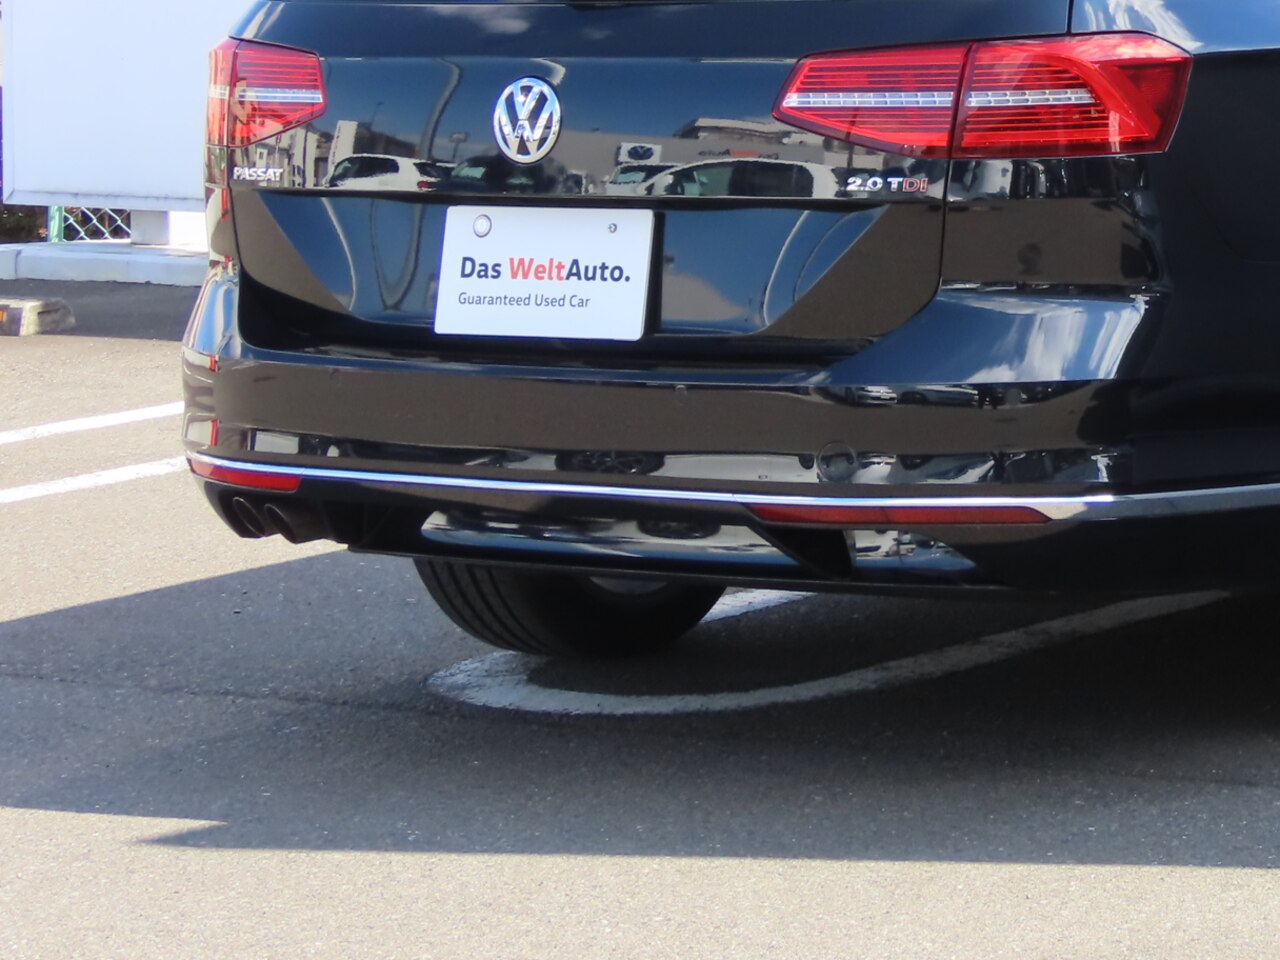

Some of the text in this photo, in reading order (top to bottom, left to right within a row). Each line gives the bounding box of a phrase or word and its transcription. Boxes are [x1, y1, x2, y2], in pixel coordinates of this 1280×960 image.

[233, 167, 284, 181] PASSAT
[846, 176, 928, 192] 2.0 TDI
[460, 257, 631, 282] Das WeltAuto.
[458, 291, 591, 308] Guaranteed Used Car
